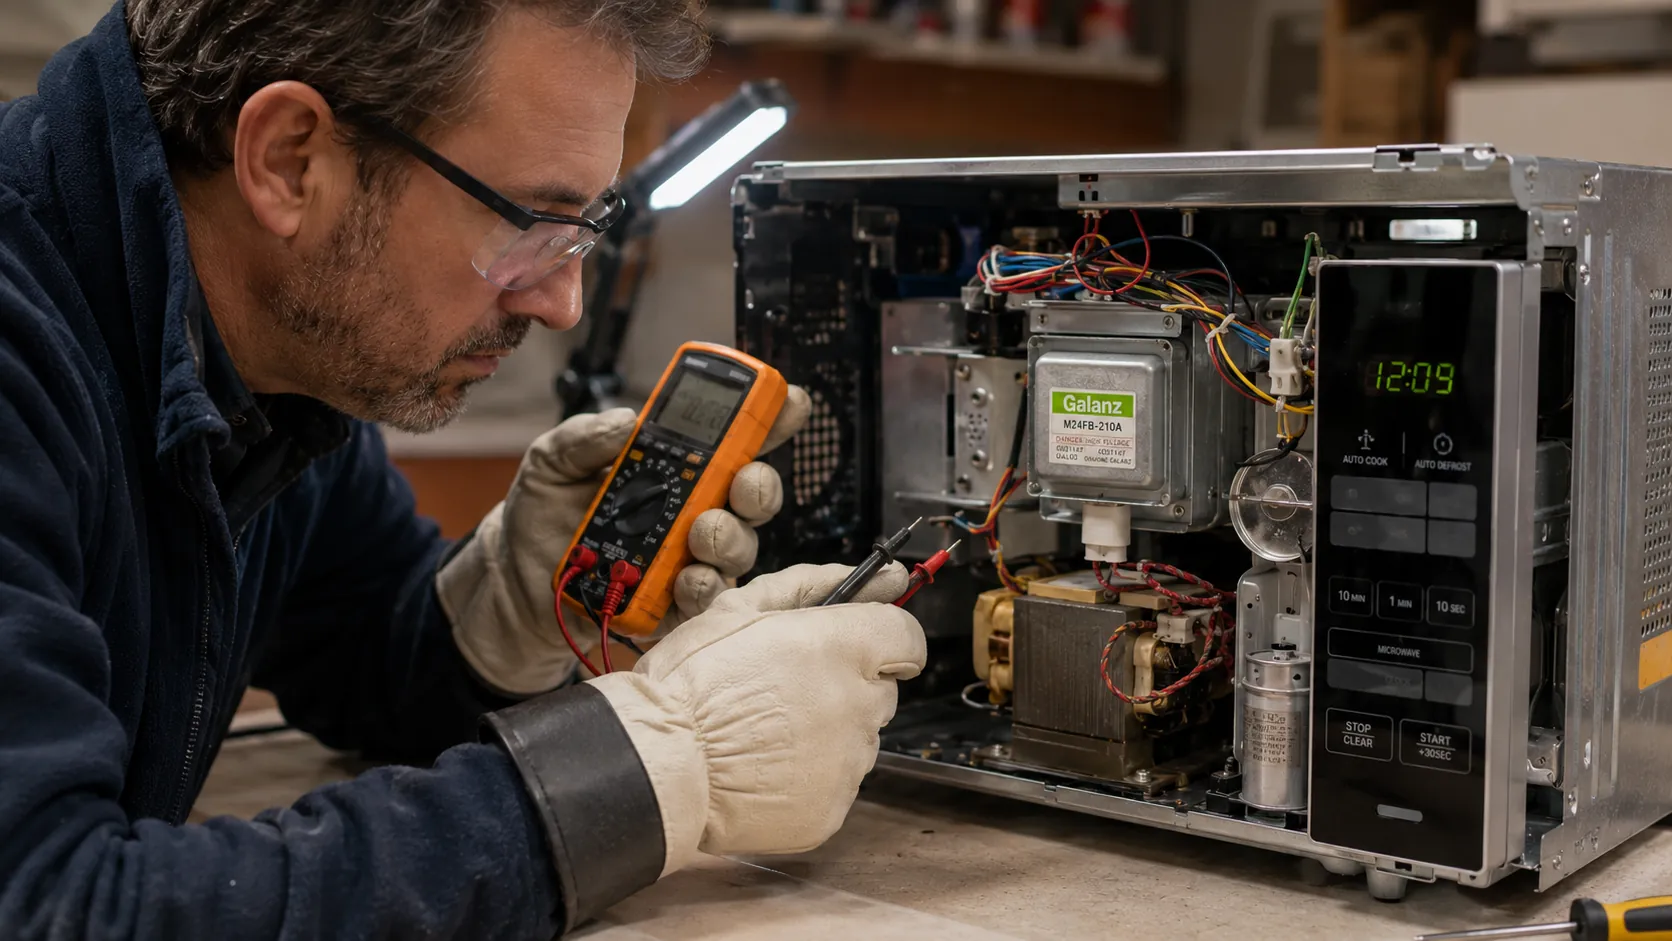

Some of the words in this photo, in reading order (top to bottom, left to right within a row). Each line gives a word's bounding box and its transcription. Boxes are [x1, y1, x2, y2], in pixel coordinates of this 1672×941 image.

[1376, 361, 1455, 395] 12:09
[1063, 394, 1122, 414] Galanz
[1063, 419, 1122, 432] M24FB-210A
[1342, 454, 1364, 465] AUTO
[1365, 455, 1388, 466] COOK
[1414, 459, 1436, 469] AUTO
[1437, 460, 1472, 471] DEFROST
[1338, 590, 1350, 601] 10
[1350, 593, 1366, 602] MIN
[1389, 595, 1395, 607] 1
[1397, 598, 1412, 608] MIN
[1436, 600, 1449, 612] 10
[1450, 603, 1466, 614] SEC
[1377, 644, 1421, 659] MICROWAVE
[1345, 721, 1372, 733] STOP
[1343, 734, 1374, 748] CLEAR
[1420, 732, 1452, 746] START
[1418, 748, 1452, 761] +30SEC
